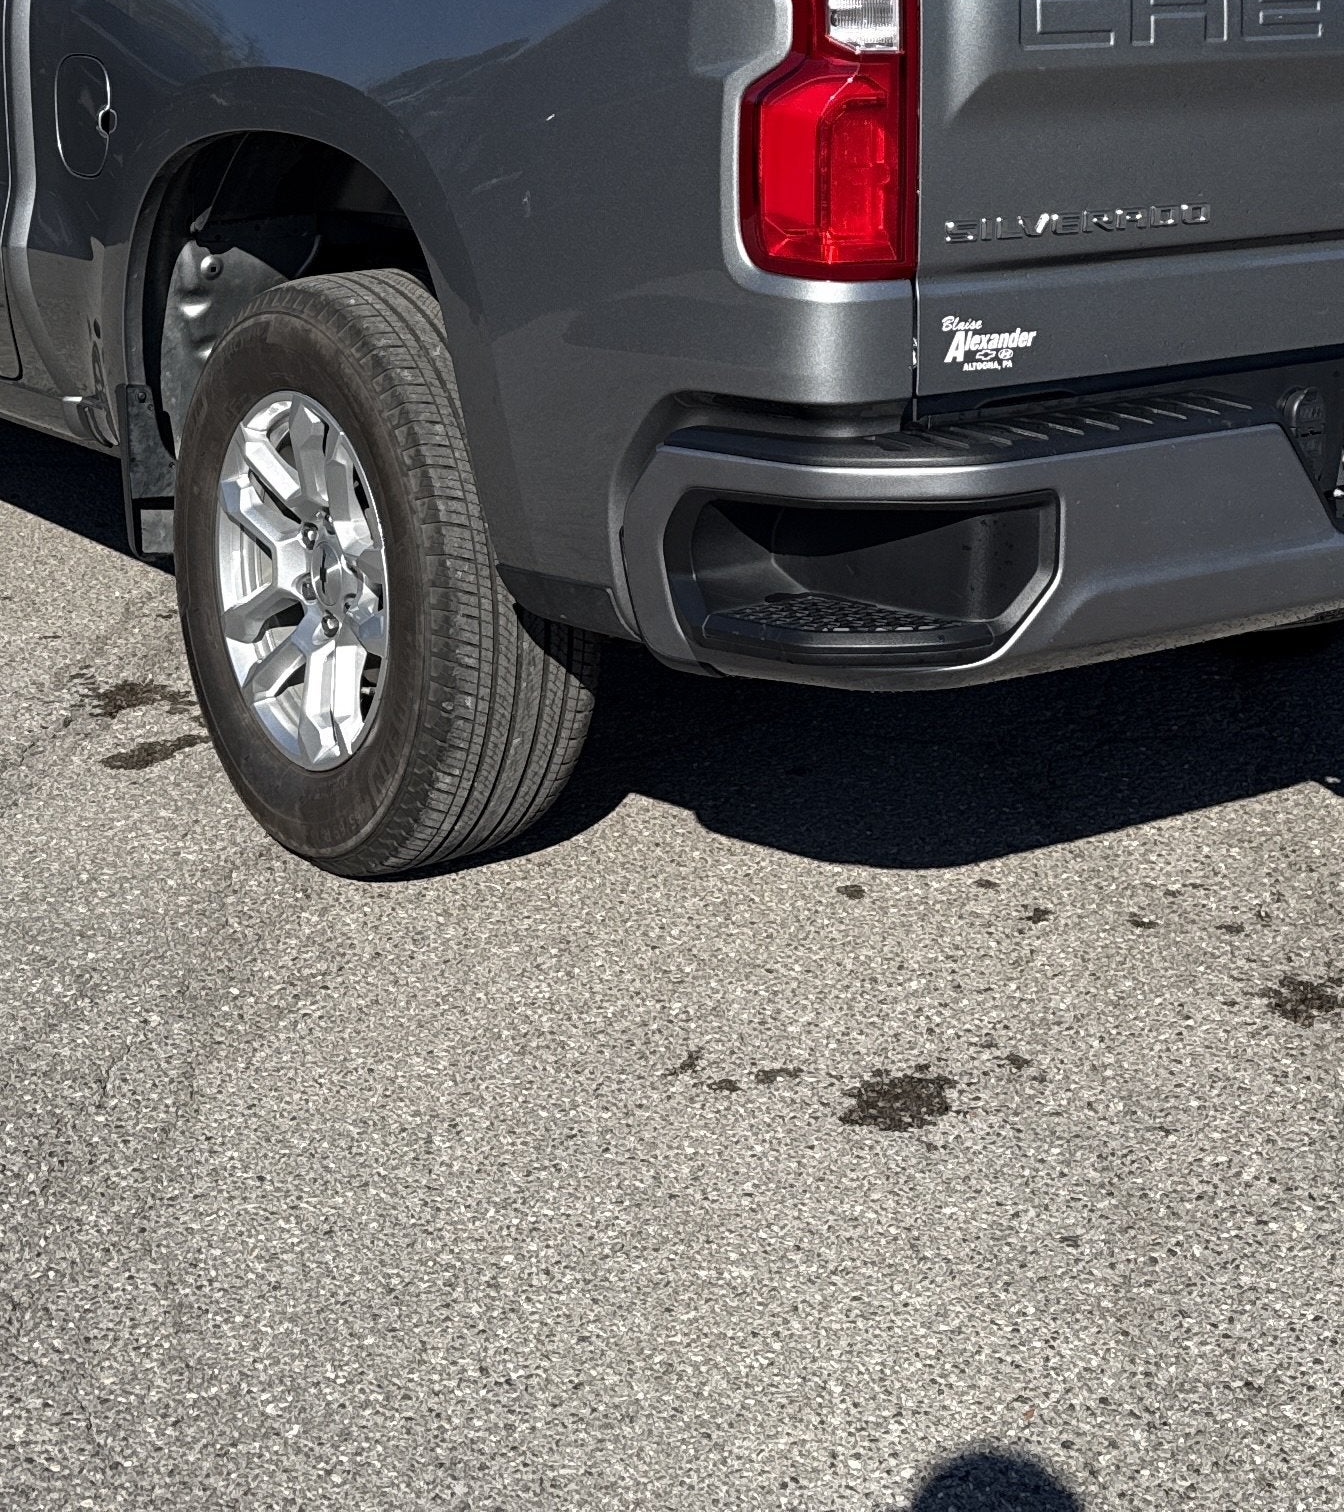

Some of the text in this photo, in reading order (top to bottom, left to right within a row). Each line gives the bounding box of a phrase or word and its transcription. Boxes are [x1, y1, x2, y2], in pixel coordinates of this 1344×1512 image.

[945, 203, 1211, 244] SILVERADO
[941, 315, 983, 332] Blaise
[944, 327, 1037, 363] Alexander
